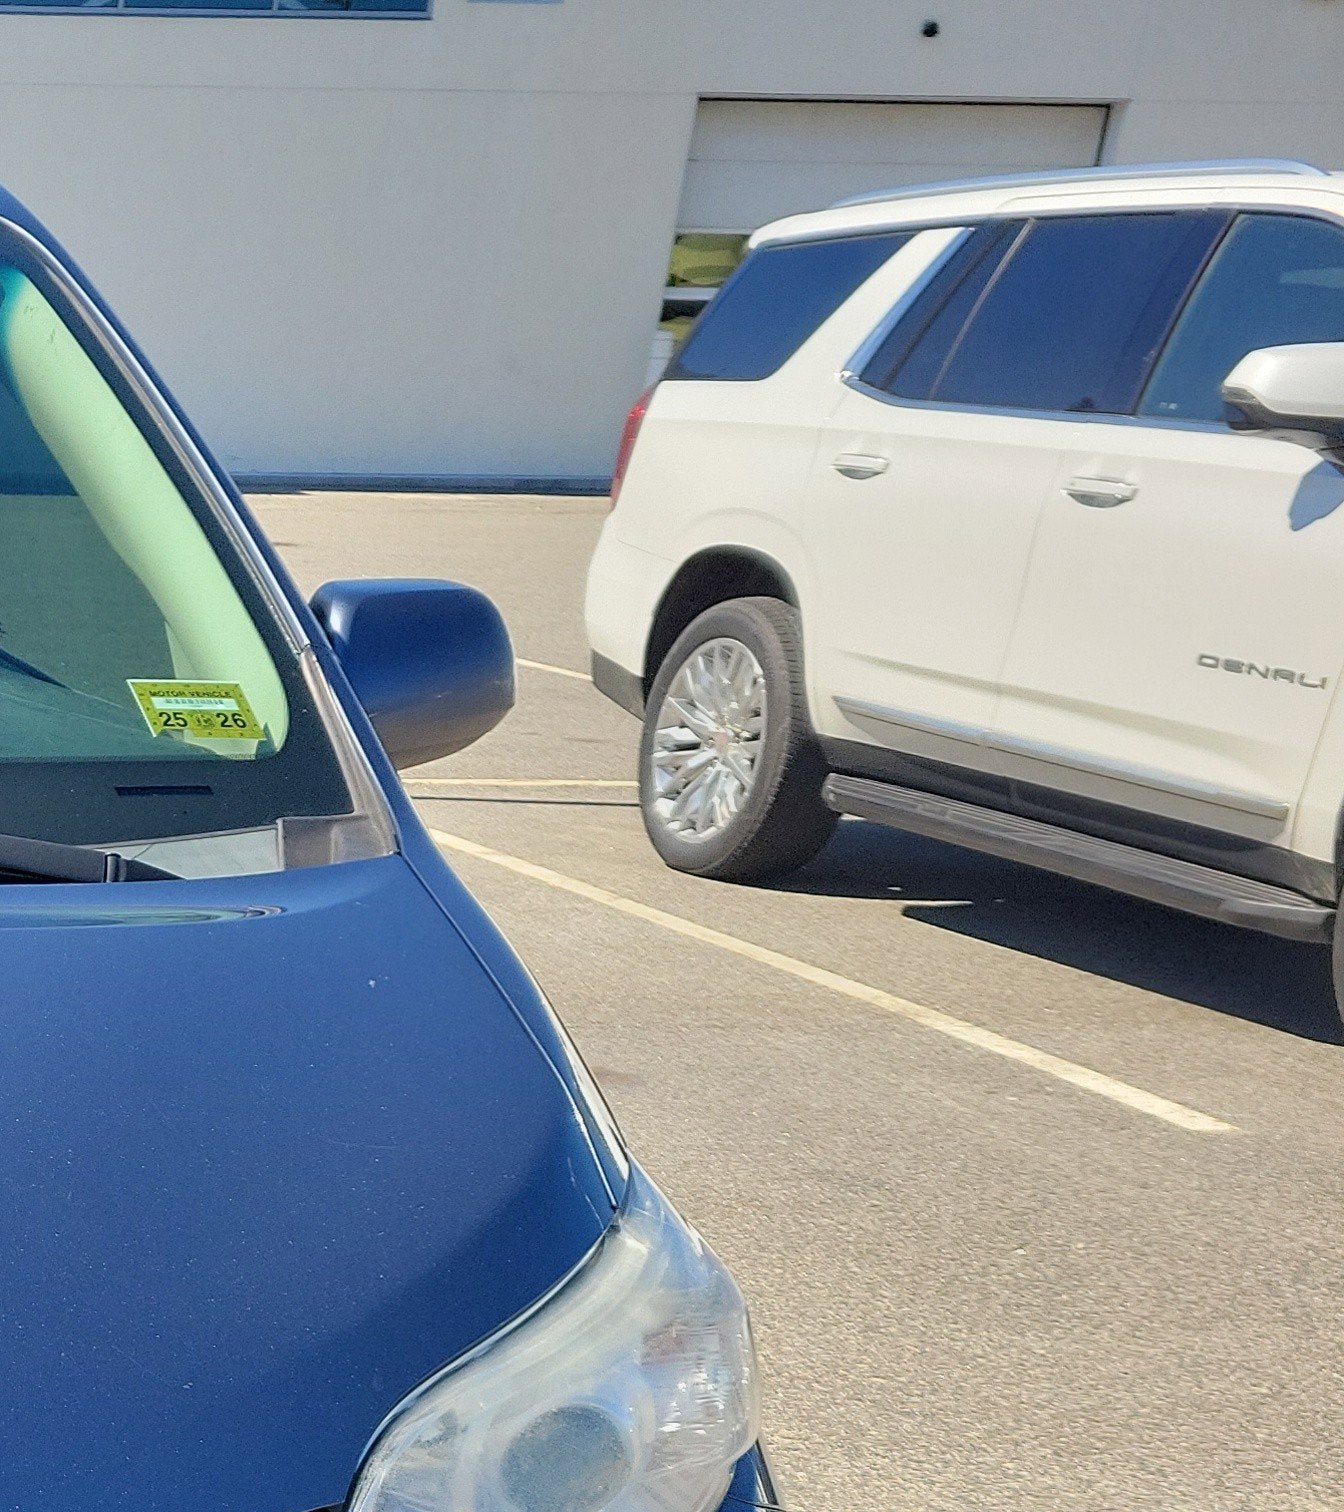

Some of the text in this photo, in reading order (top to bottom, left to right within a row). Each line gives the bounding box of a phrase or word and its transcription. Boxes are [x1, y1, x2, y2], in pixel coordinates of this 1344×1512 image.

[1196, 652, 1329, 690] DENALI
[148, 690, 233, 699] MOTOR VEHICLE
[158, 711, 189, 728] 25
[215, 712, 248, 730] 26
